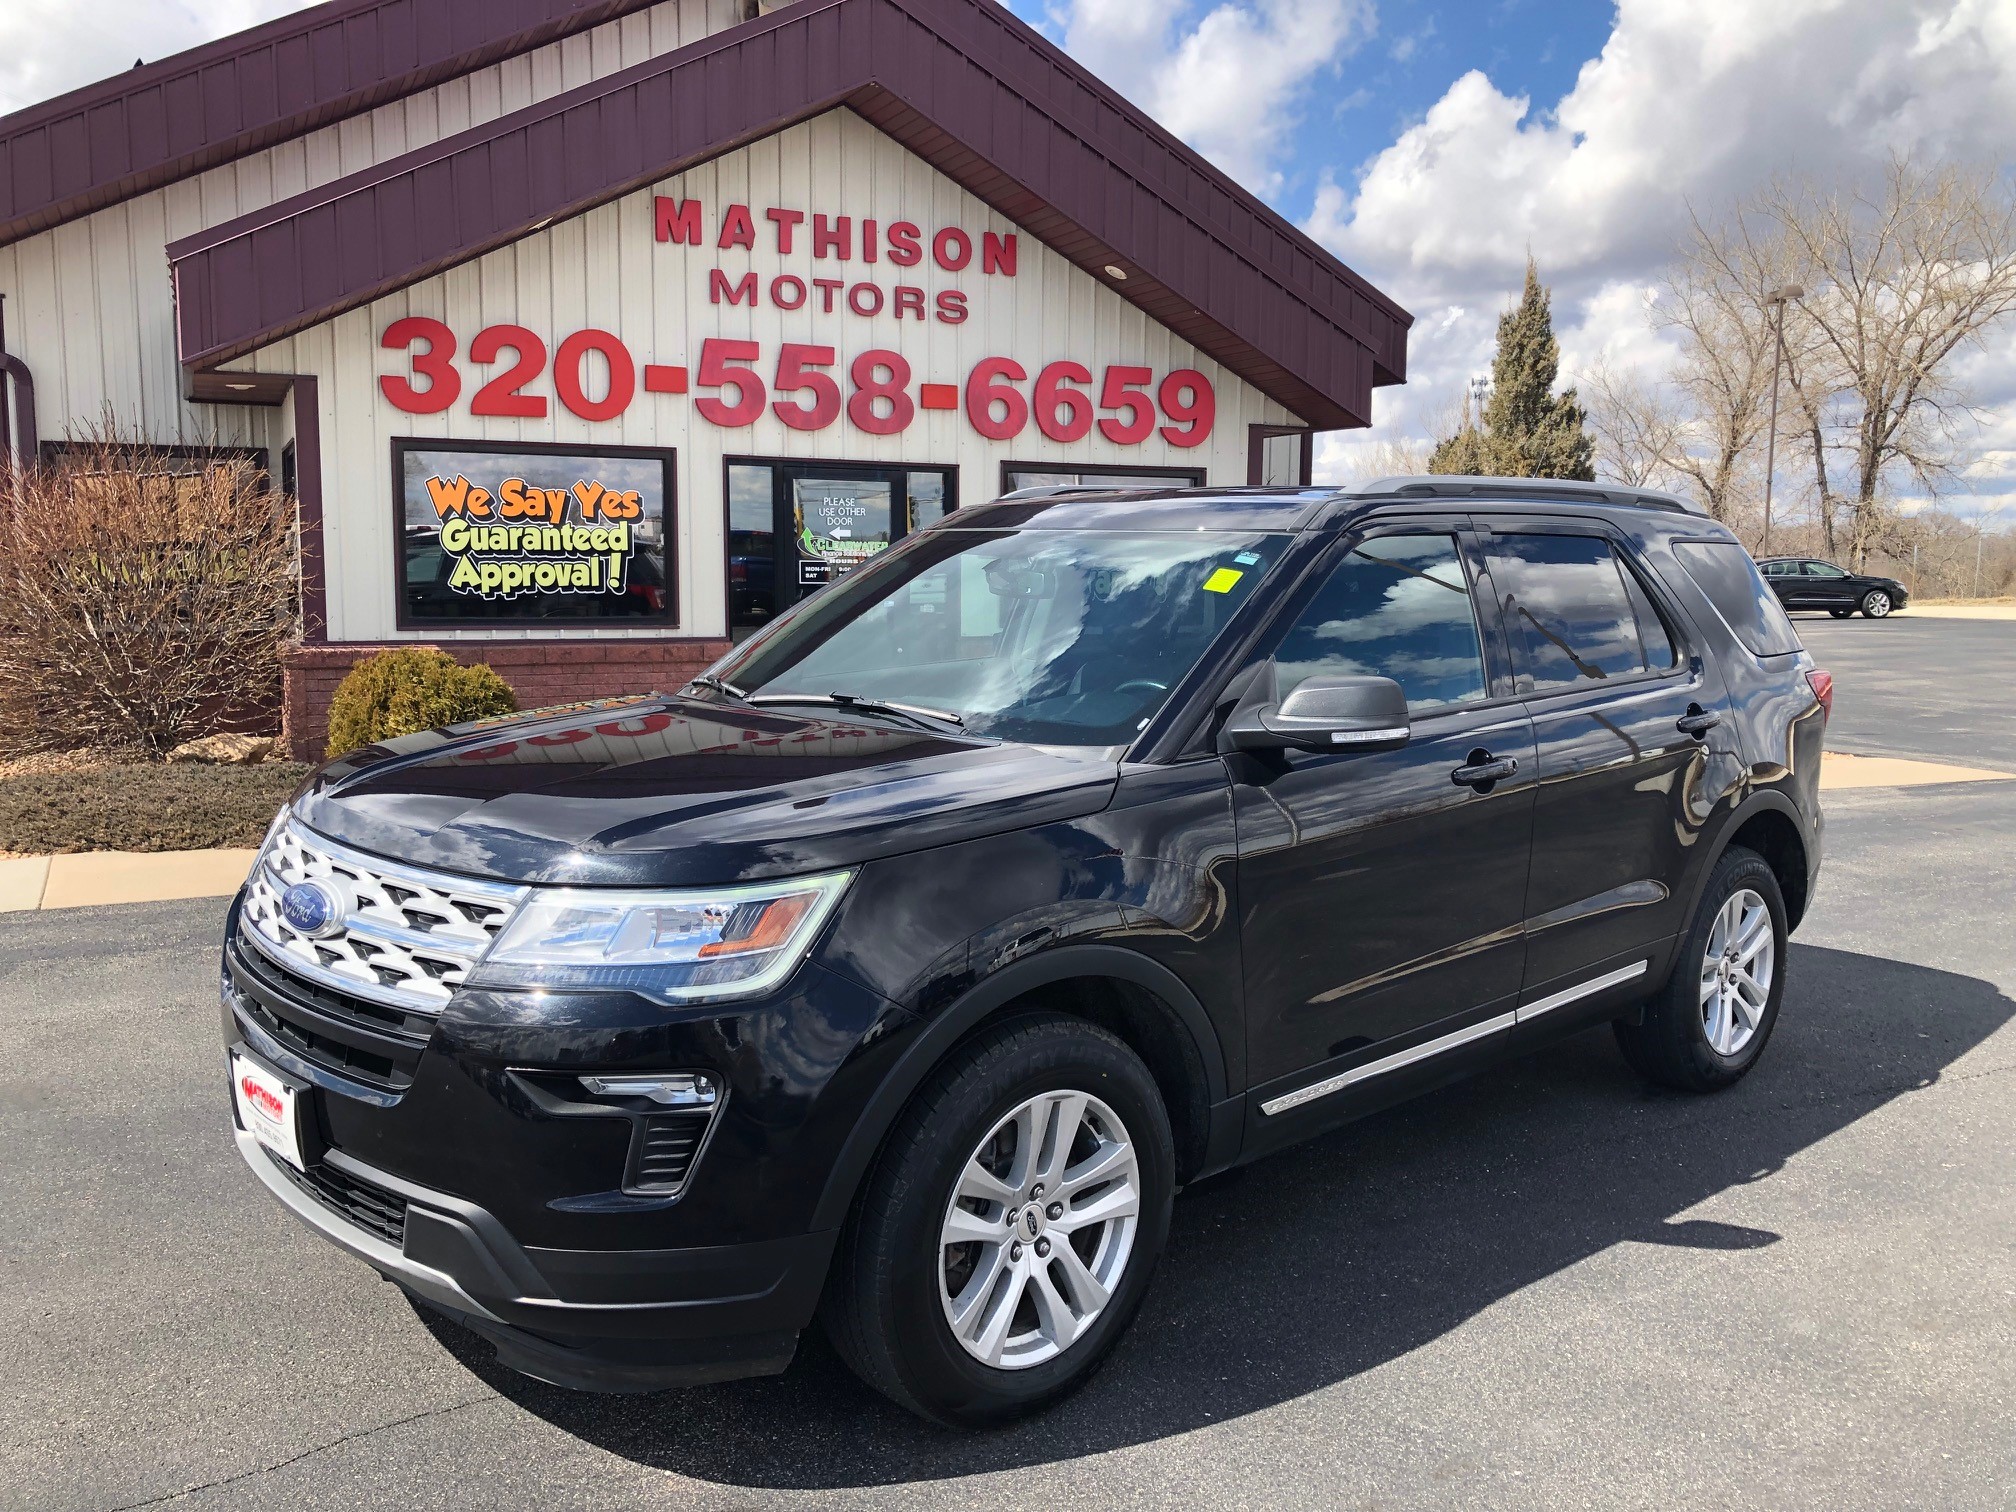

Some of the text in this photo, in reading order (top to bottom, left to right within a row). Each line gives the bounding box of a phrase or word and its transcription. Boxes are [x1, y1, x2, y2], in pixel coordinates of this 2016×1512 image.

[654, 195, 1017, 277] MATHISON
[710, 268, 969, 323] MOTORS
[379, 316, 1216, 448] 320-558-6659
[424, 473, 644, 525] We Say Yes
[818, 507, 866, 517] USE OTHER
[823, 497, 856, 507] PLEASE
[440, 517, 634, 557] Guaranteed
[826, 517, 853, 526] DOOR
[816, 538, 889, 551] CLEARWATER
[449, 552, 626, 600] Approval!
[286, 889, 316, 923] Ford
[242, 1076, 284, 1114] MATHISON
[1269, 1079, 1344, 1112] EXPLORER
